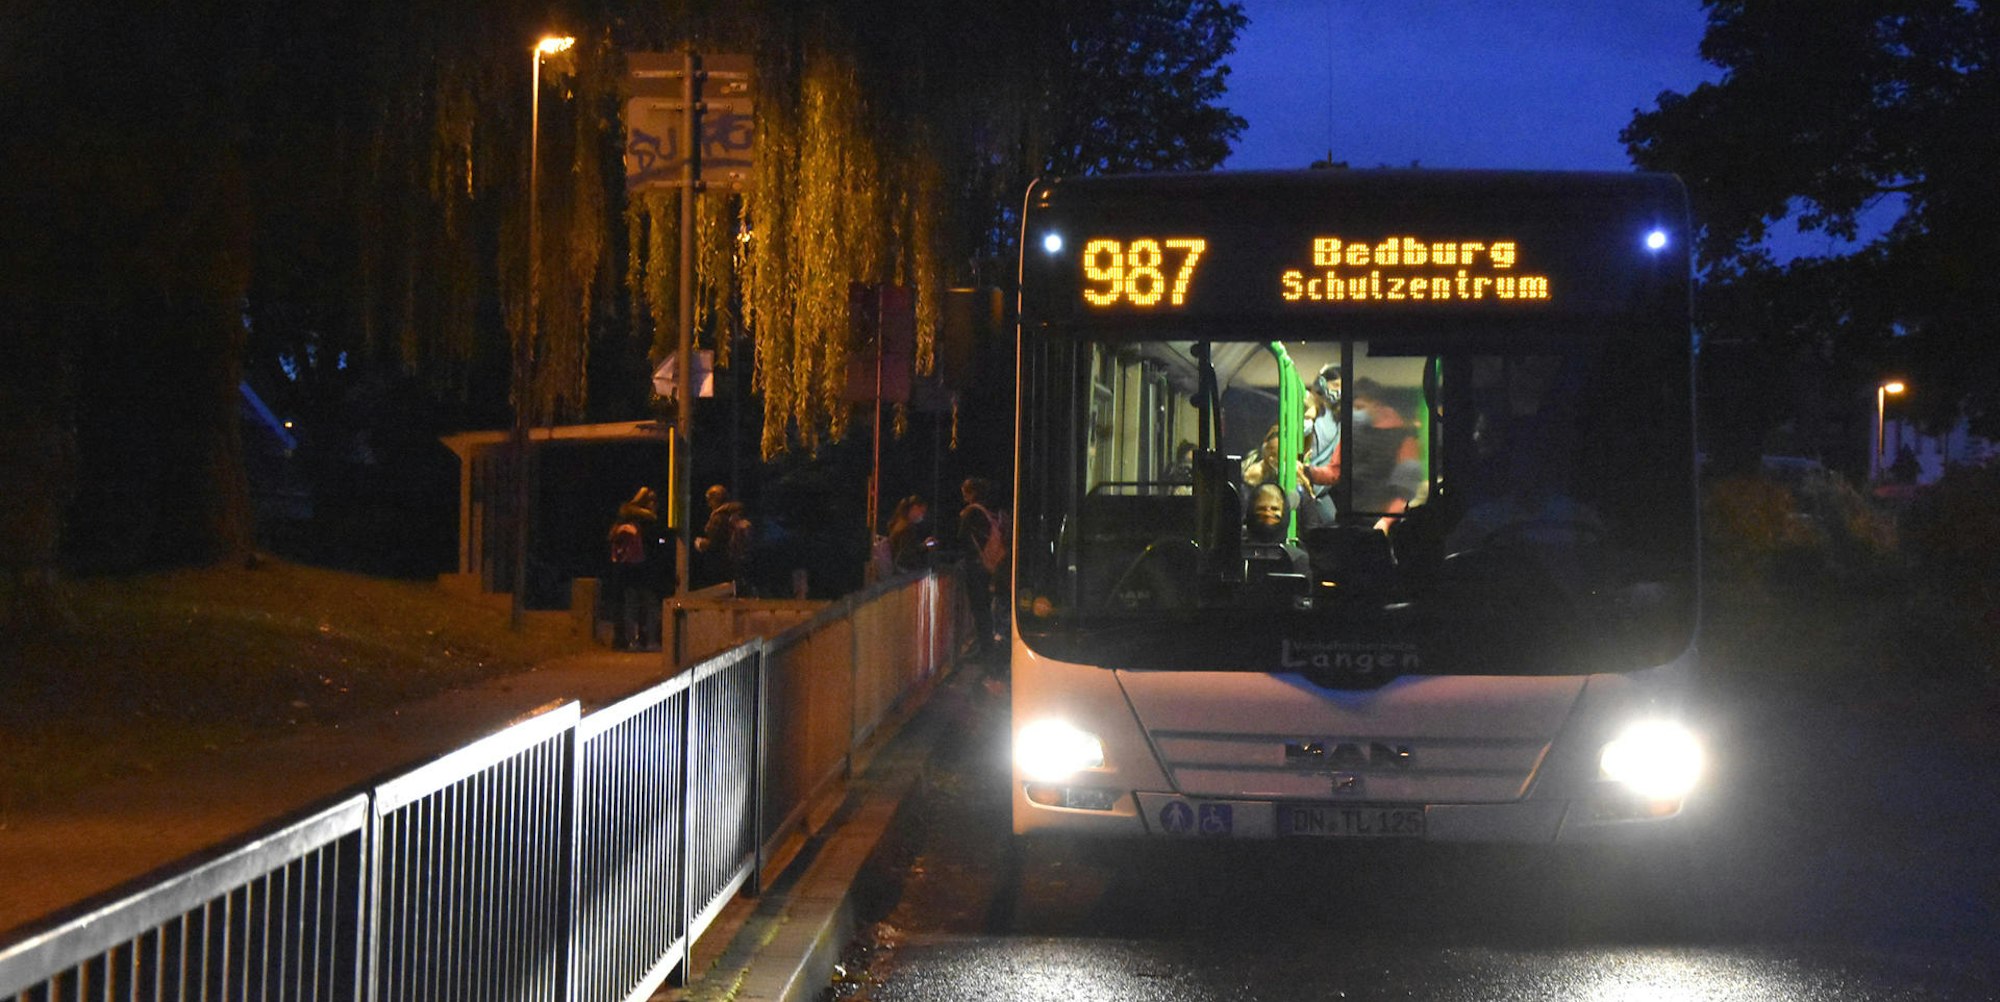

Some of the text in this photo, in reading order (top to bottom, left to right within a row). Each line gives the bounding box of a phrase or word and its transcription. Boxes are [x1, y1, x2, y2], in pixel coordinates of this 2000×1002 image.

[1313, 237, 1517, 268] Bedburg
[1083, 238, 1207, 307] 987
[1282, 269, 1550, 301] Schulzentrum
[1281, 639, 1420, 672] Langen
[1285, 741, 1410, 768] MAN
[1378, 810, 1420, 833] 125
